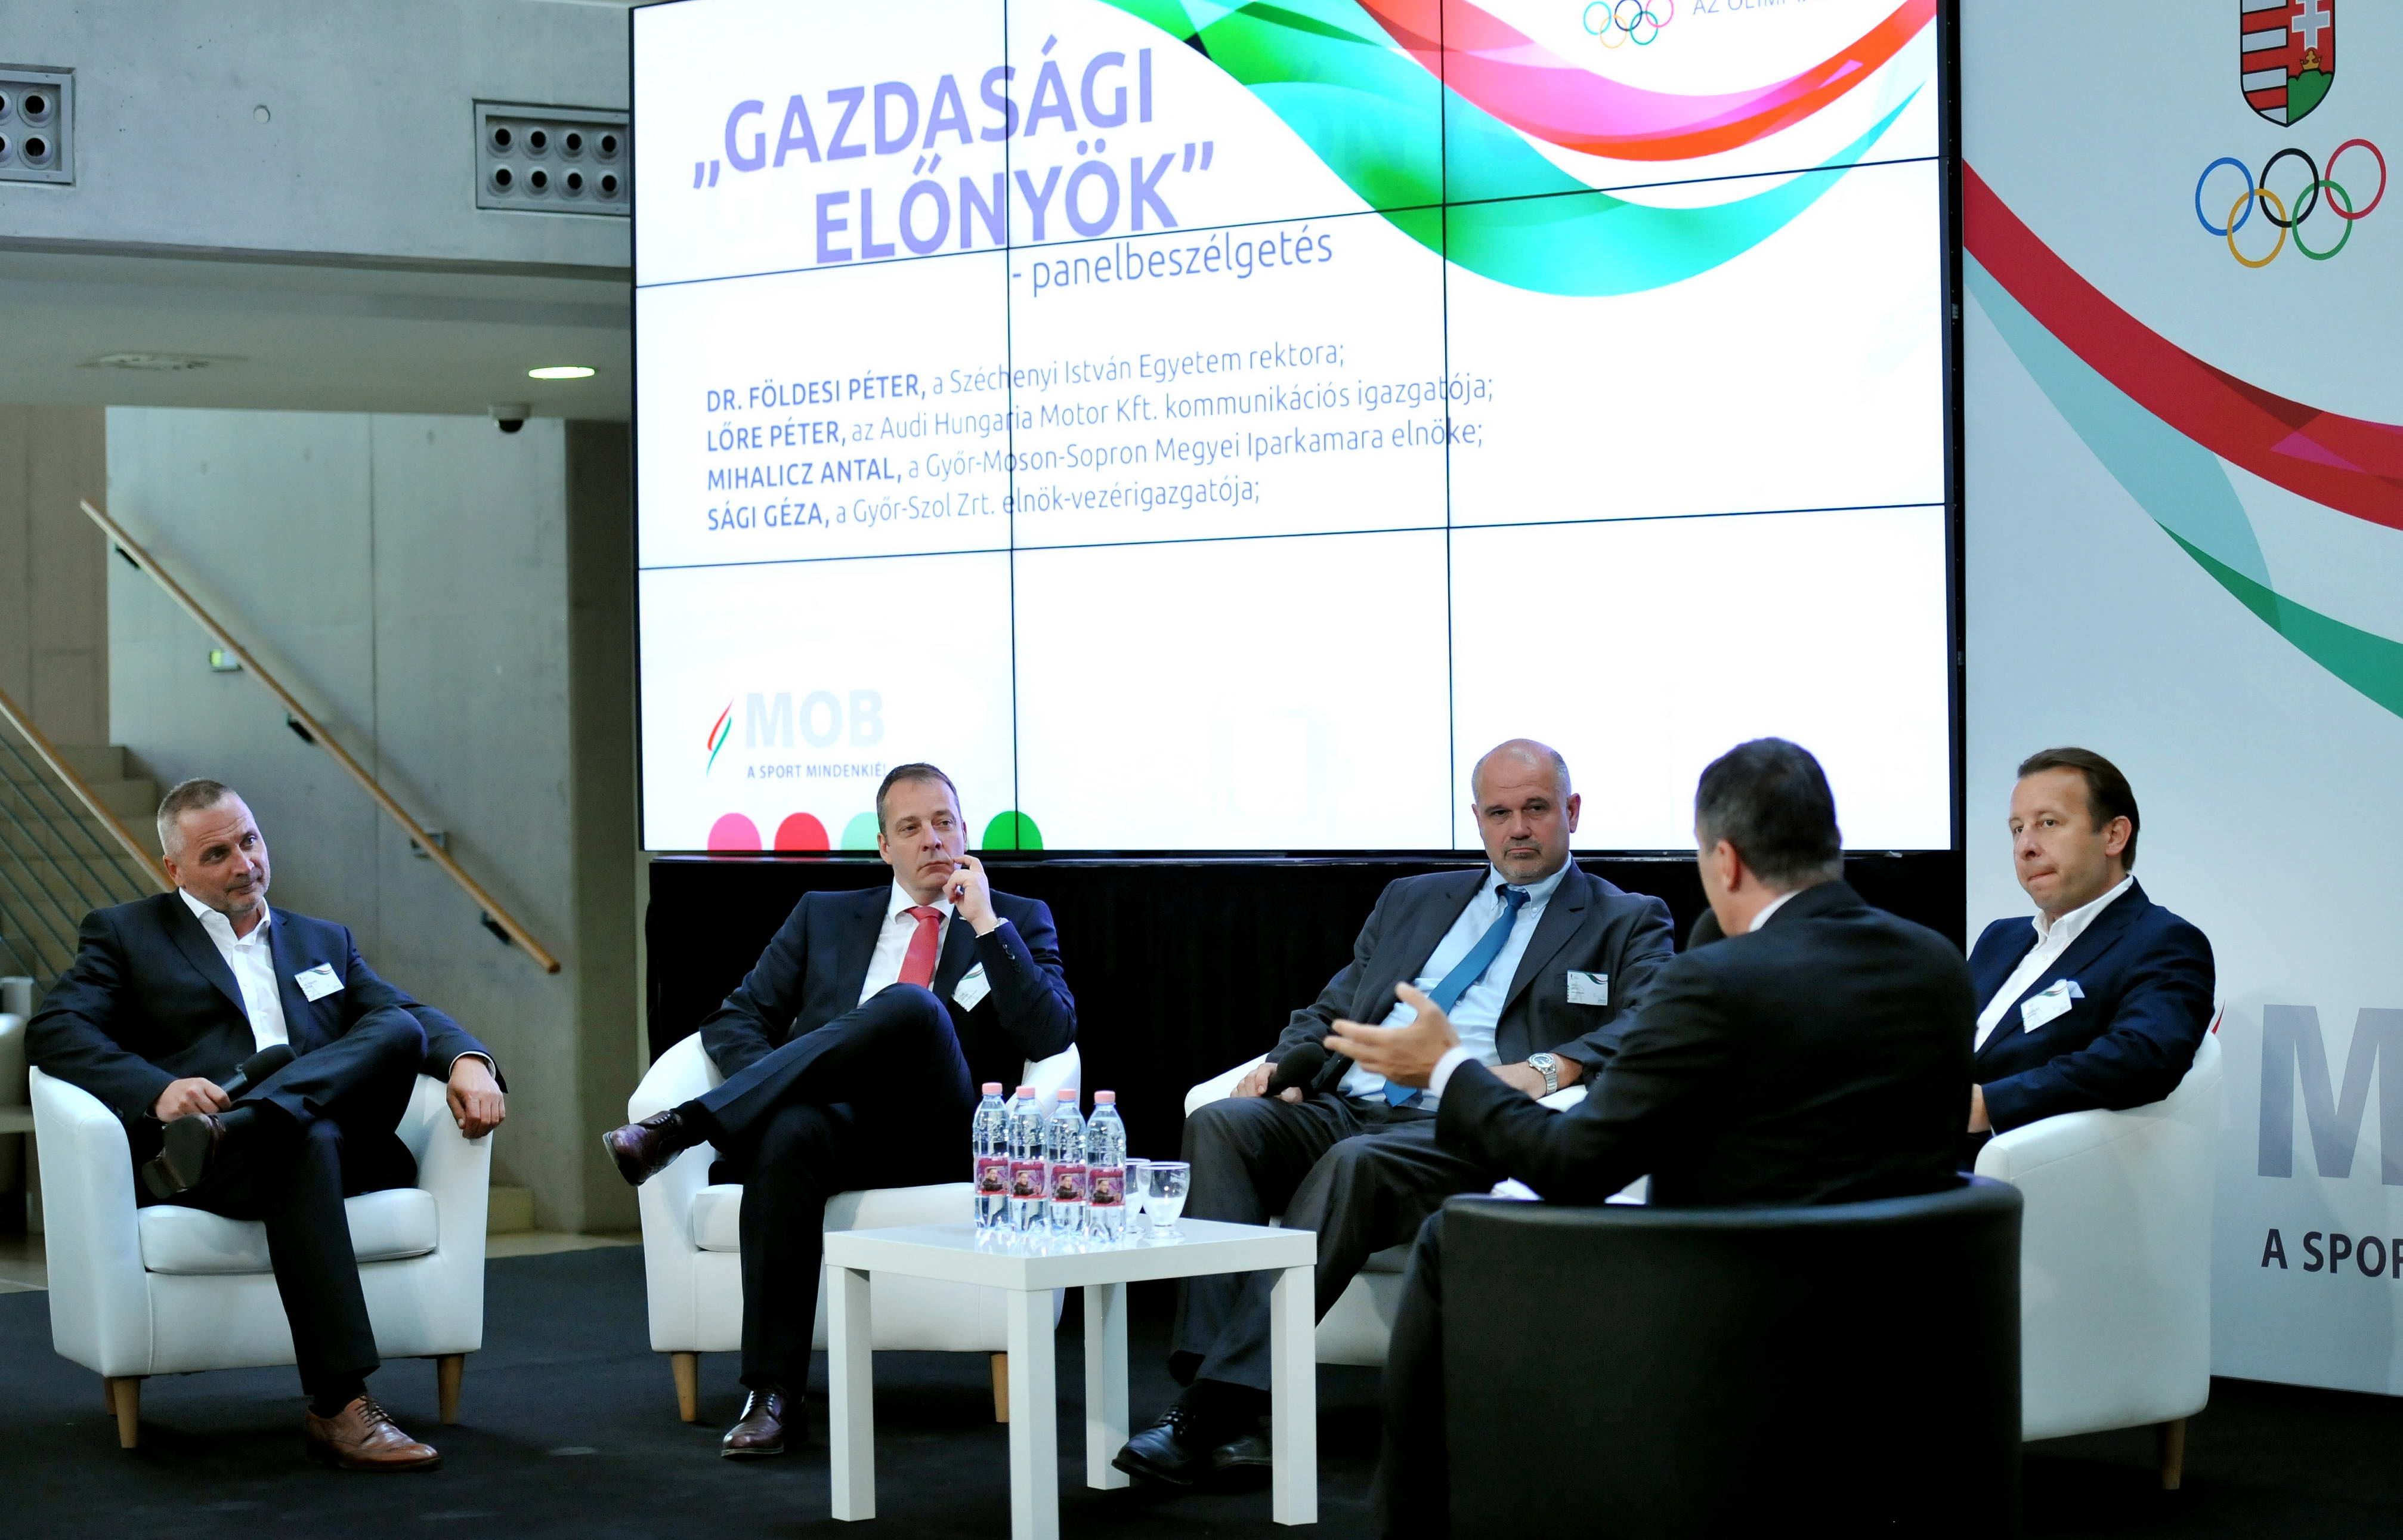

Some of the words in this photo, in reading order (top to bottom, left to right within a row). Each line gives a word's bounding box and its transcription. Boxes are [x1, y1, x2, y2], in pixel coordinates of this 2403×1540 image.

[692, 33, 1152, 190] „GAZDASÁGI
[815, 138, 1215, 264] ELŐNYÖK”
[1033, 224, 1333, 297] panelbeszélgetés
[707, 388, 742, 413] DR.
[749, 379, 840, 409] FÖLDESI
[849, 369, 926, 401] PÉTER,
[933, 377, 943, 395] a
[950, 360, 1057, 394] Széchenyi
[1066, 355, 1131, 384] István
[1140, 351, 1241, 383] Egyetem
[1250, 341, 1344, 369] rektora;
[707, 421, 763, 452] LŐRE
[770, 416, 846, 447] PÉTER,
[852, 423, 874, 442] az
[880, 412, 926, 439] Audi
[935, 405, 1032, 439] Hungaria
[1041, 403, 1109, 427] Motor
[1117, 394, 1157, 422] Kft.
[1167, 382, 1350, 419] kommunikációs
[1358, 372, 1492, 411] igazgatója;
[707, 462, 814, 491] MIHALICZ
[820, 457, 901, 484] ANTAL,
[908, 460, 918, 478] a
[926, 443, 1147, 482] Győr-Moson-Sopron
[1156, 432, 1239, 466] Megyei
[1248, 426, 1383, 462] Iparkamara
[1392, 418, 1482, 449] elnöke;
[707, 497, 756, 531] SÁGI
[764, 496, 829, 528] GÉZA,
[836, 506, 846, 524] a
[853, 491, 951, 528] Győr-Szol
[957, 493, 995, 517] Zrt.
[1003, 475, 1259, 514] elnök-vezérigazgatója;
[746, 689, 884, 749] MOB
[747, 766, 755, 778] A
[760, 765, 802, 778] SPORT
[2261, 1228, 2288, 1269] A
